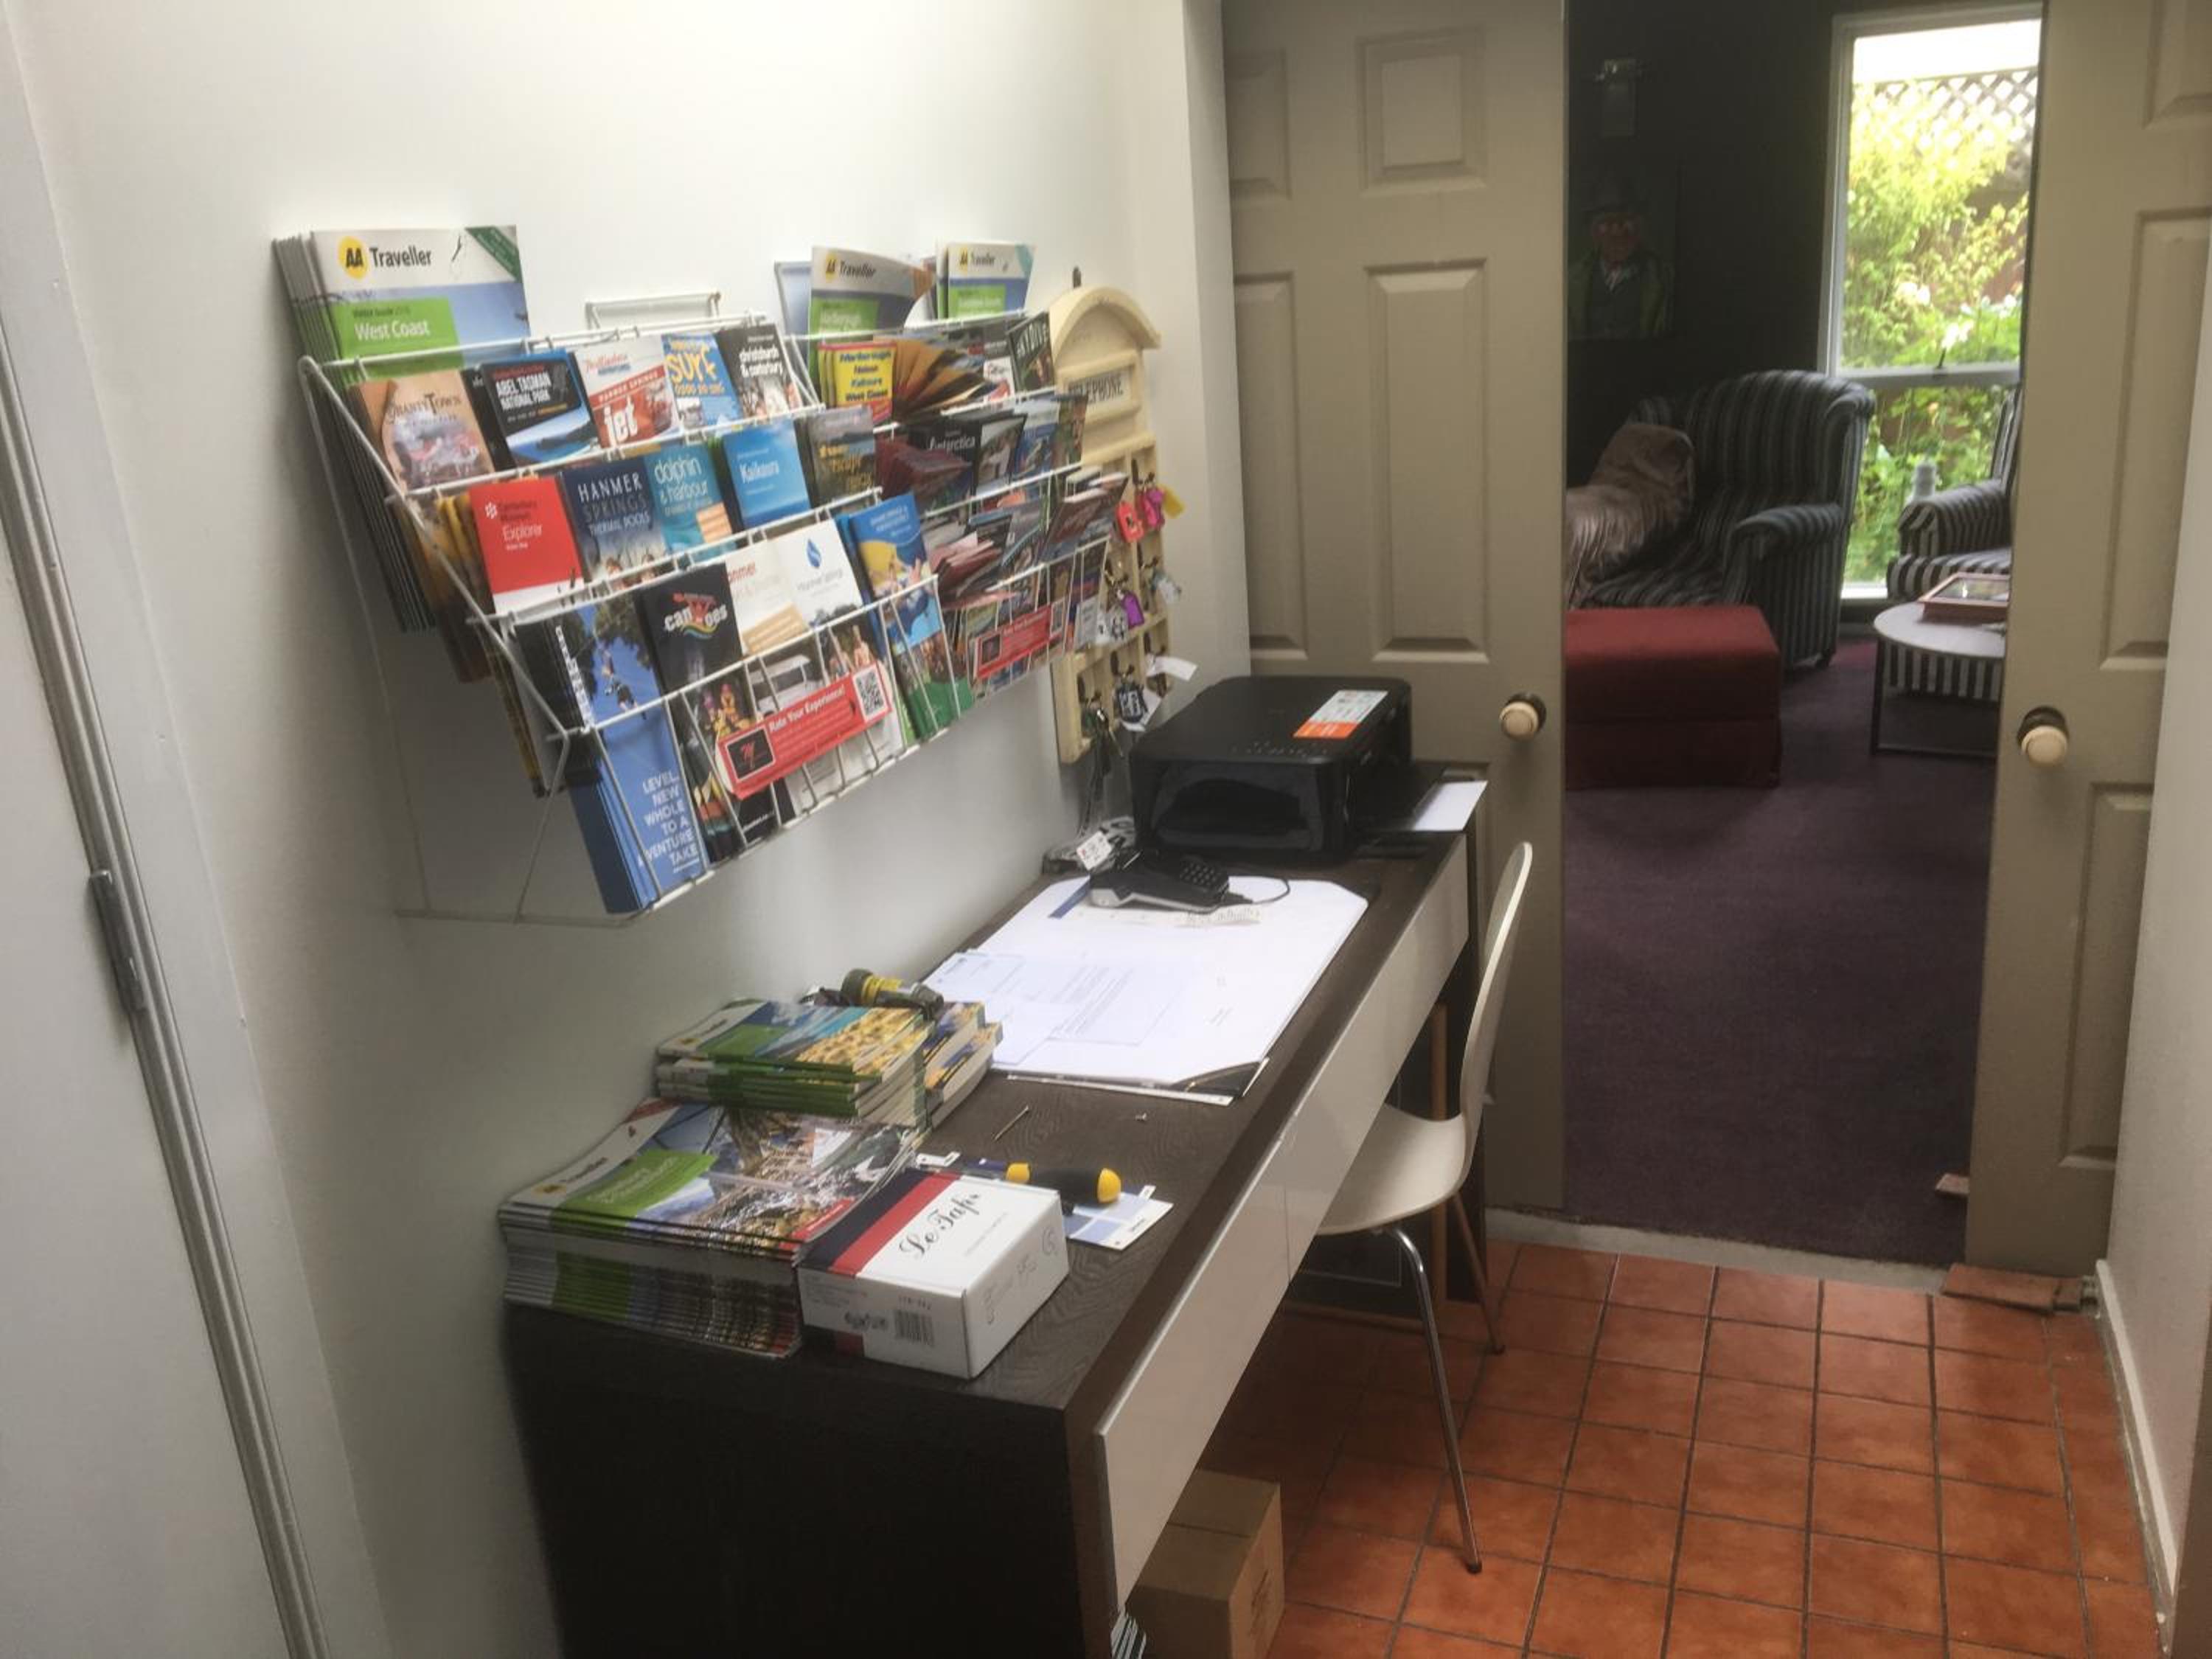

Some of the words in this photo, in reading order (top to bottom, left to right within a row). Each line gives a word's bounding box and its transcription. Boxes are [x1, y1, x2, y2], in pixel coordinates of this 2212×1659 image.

[345, 247, 364, 268] AA
[369, 246, 432, 268] Traveller
[839, 263, 876, 278] Traveller
[355, 321, 389, 341] West
[391, 319, 430, 337] Coast
[495, 378, 519, 397] ABEL
[517, 371, 552, 392] TASMAN
[501, 392, 532, 411] NATIONAL
[531, 388, 551, 403] PARK
[577, 471, 643, 503] HANMER
[642, 771, 680, 795] LEVEL
[652, 785, 681, 807] NEW
[644, 800, 686, 827] WHOLE
[661, 820, 678, 836] TO
[680, 815, 690, 829] A
[636, 830, 695, 868] AVENTURE
[668, 844, 698, 865] TAKE
